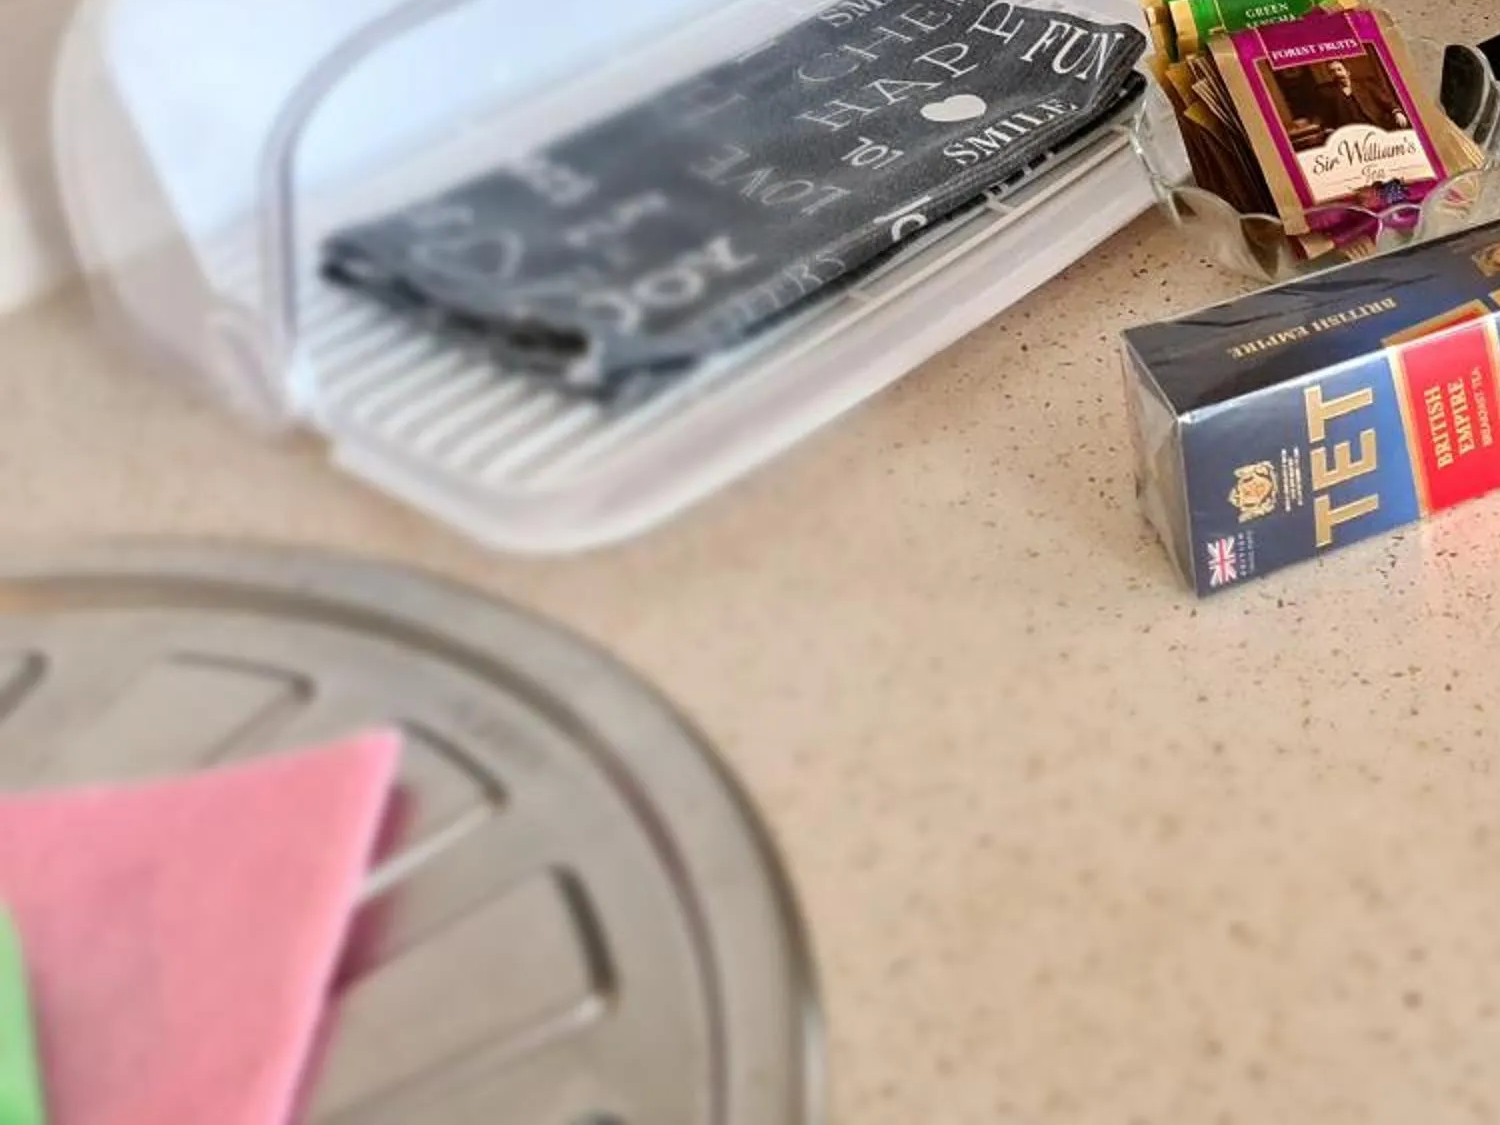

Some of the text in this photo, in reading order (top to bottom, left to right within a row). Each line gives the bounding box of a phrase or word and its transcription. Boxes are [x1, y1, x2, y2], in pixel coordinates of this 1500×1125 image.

[1244, 2, 1290, 19] GREEN
[1019, 18, 1125, 81] FUN
[1271, 38, 1359, 61] FOREST FRUITS
[1312, 130, 1417, 176] Sir William's
[1226, 296, 1398, 360] BRITISH EMPIRE
[1423, 384, 1455, 470] BRITISH
[1447, 377, 1476, 456] EMPIRE
[1303, 384, 1380, 548] TET
